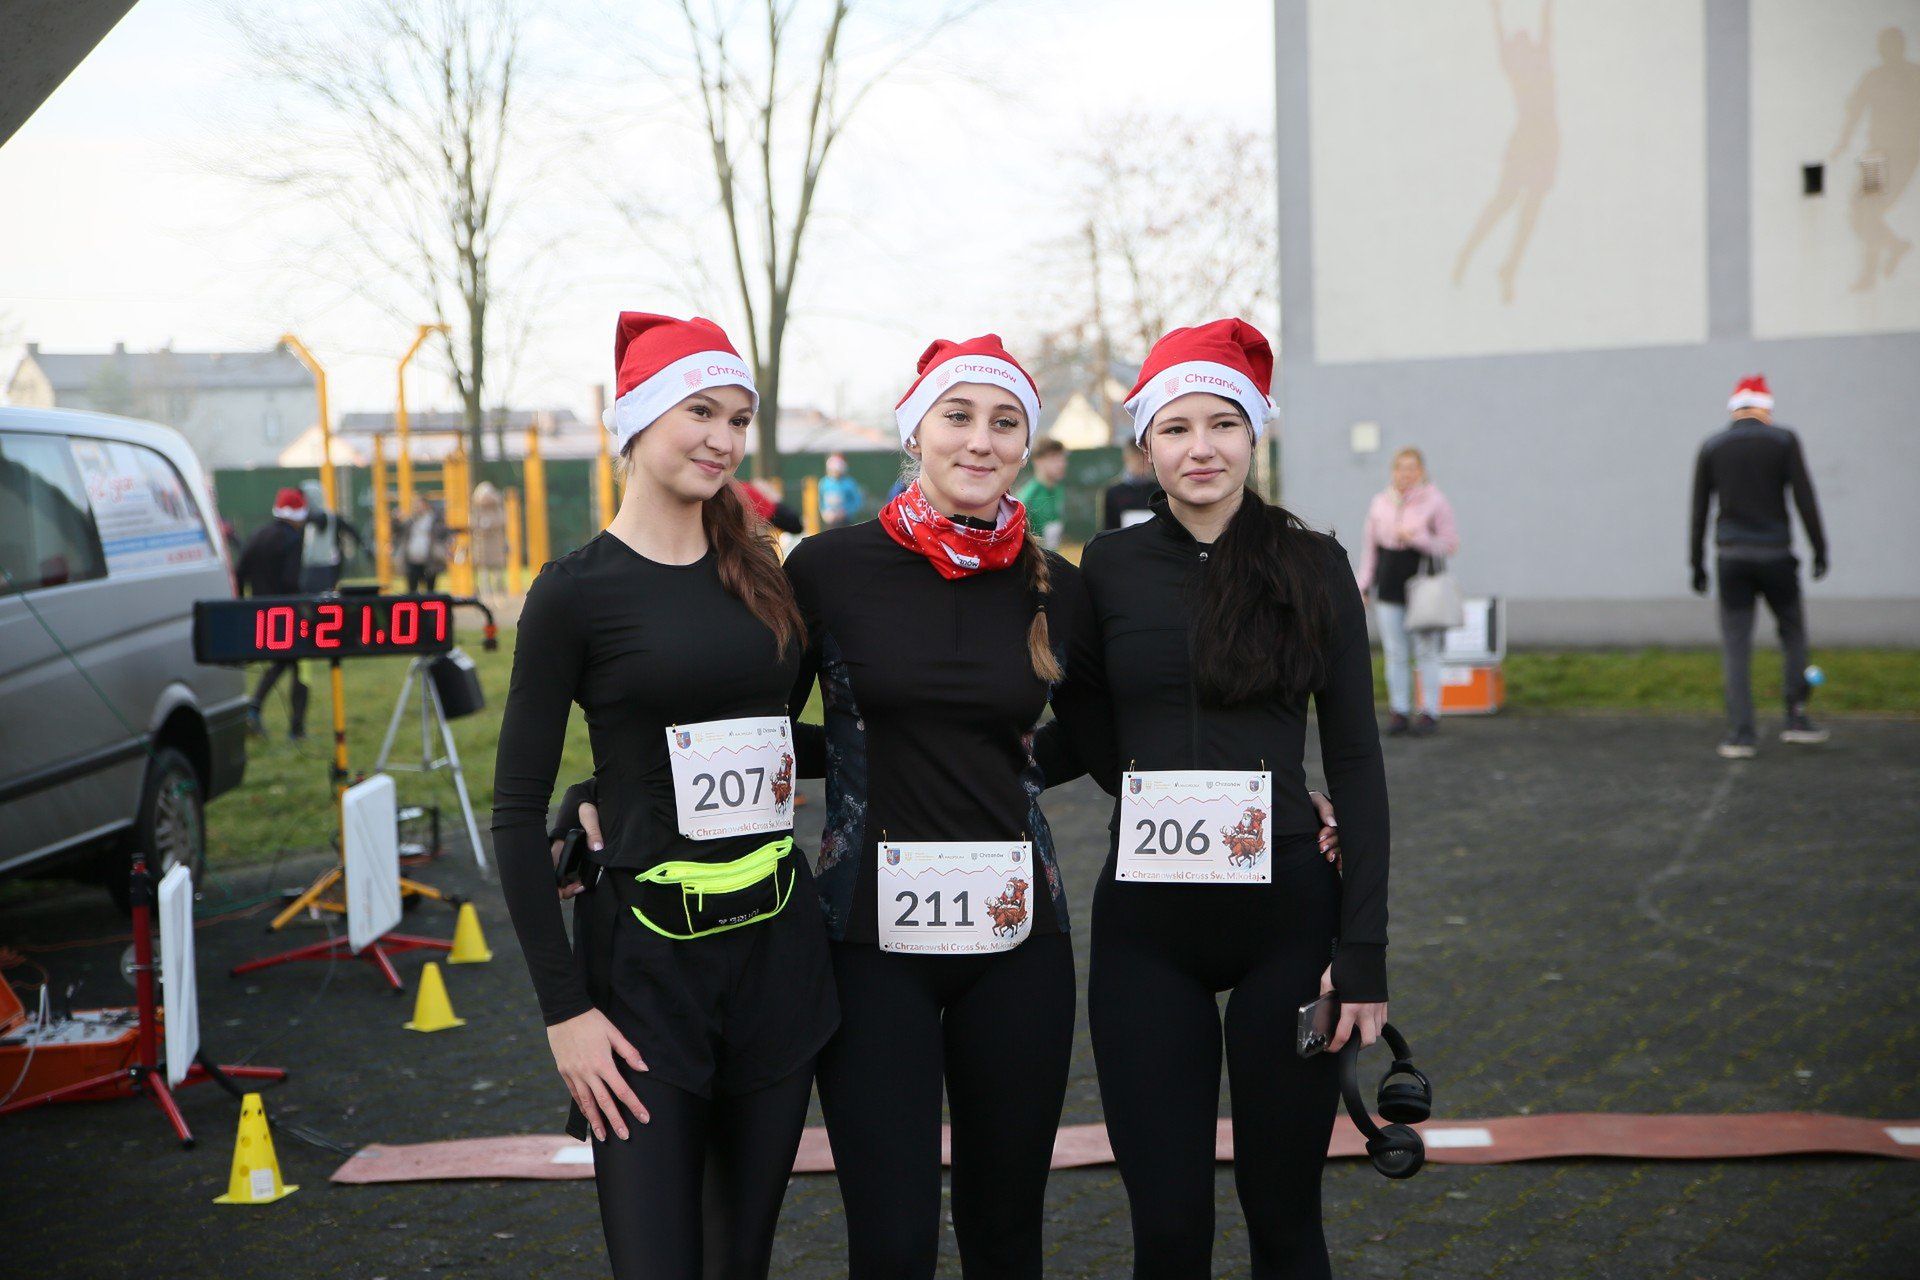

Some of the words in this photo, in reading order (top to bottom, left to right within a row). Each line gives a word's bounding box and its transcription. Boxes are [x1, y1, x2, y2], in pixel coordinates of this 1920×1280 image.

[954, 363, 1017, 384] Chrzanów
[1184, 373, 1242, 395] Chrzanów
[692, 767, 765, 812] 207
[1134, 818, 1211, 856] 206
[1132, 870, 1184, 879] Chrzanowski
[1185, 871, 1209, 879] Cross
[894, 890, 975, 927] 211
[895, 942, 949, 951] Chrzanowski
[950, 942, 974, 951] Cross
